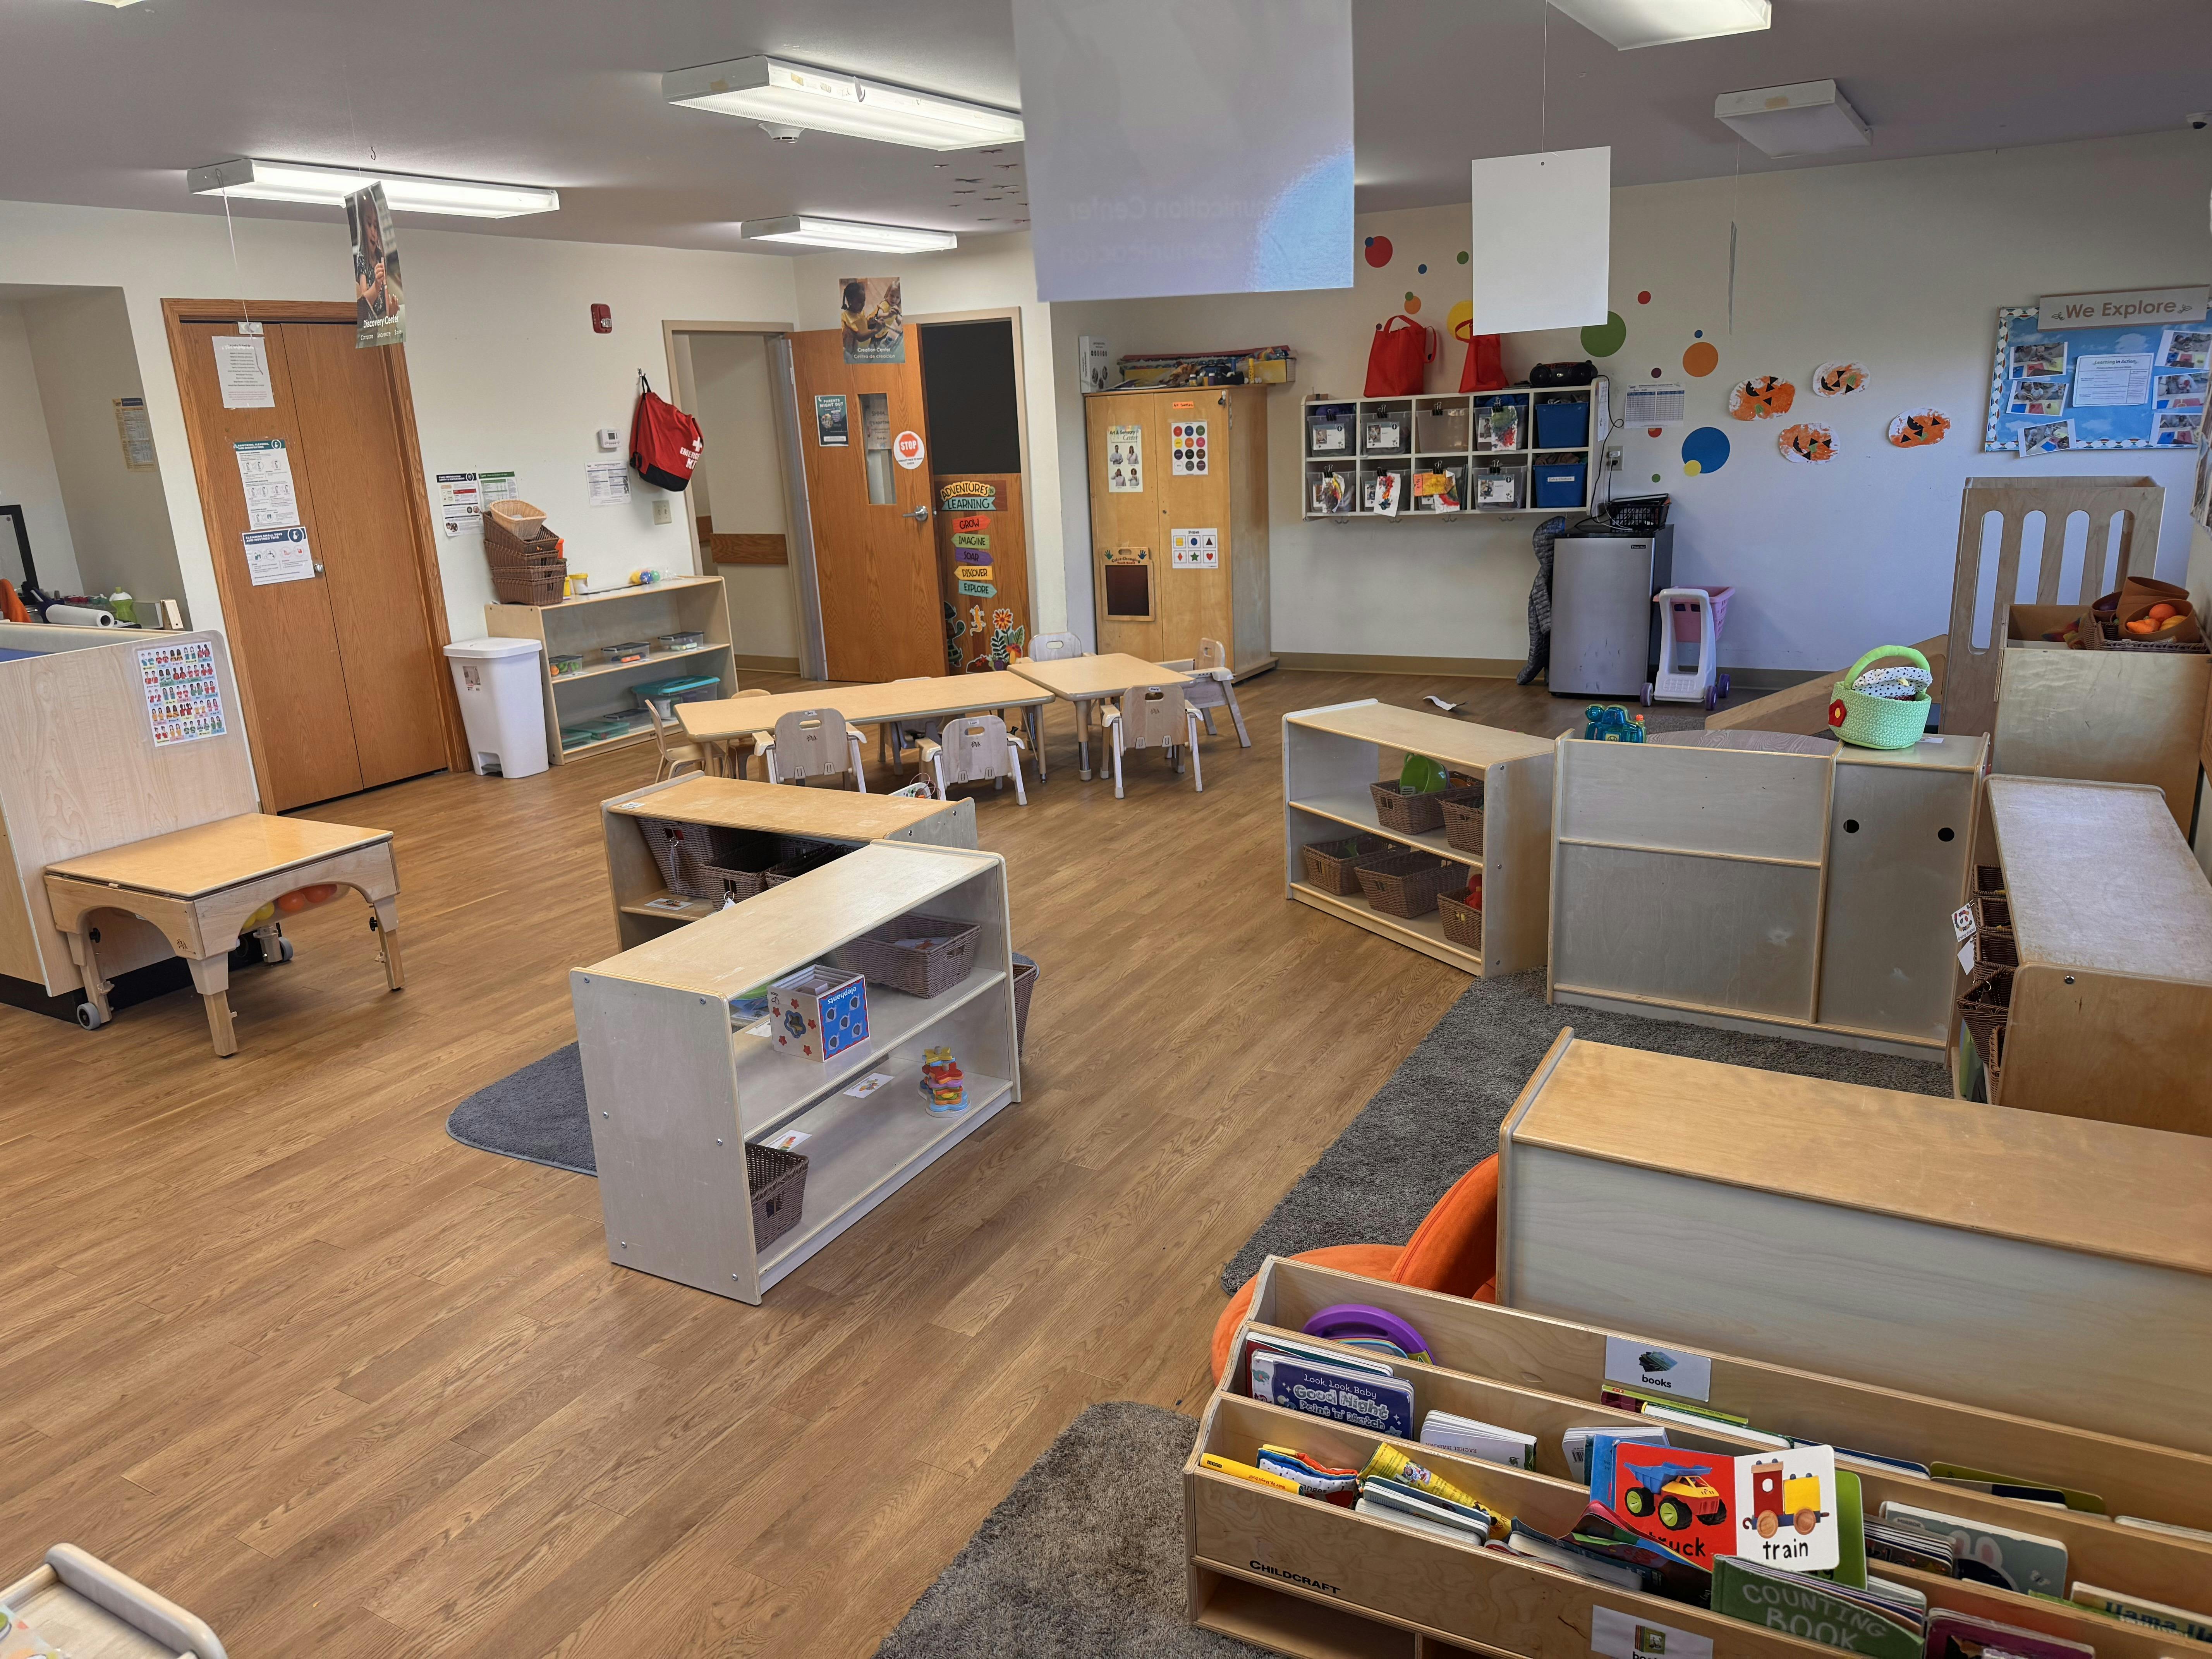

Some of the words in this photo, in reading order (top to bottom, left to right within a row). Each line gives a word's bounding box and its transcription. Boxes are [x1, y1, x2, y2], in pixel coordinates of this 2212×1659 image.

[2066, 304, 2094, 318] We
[2102, 300, 2176, 318] Explore
[363, 318, 384, 328] Discovery
[385, 314, 398, 325] Center
[900, 440, 917, 451] STOP
[685, 458, 697, 470] KI
[941, 483, 988, 500] ADVENTURES
[947, 498, 990, 510] LEARNING
[959, 519, 979, 529] GROW
[959, 536, 986, 545] IMAGINE
[963, 551, 979, 562] SOAR
[962, 568, 988, 577] DISCOVER
[963, 583, 989, 594] EXPLORE
[828, 986, 857, 1004] elephants
[1304, 1374, 1327, 1387] Look,
[1329, 1380, 1352, 1393] Look,
[1353, 1386, 1376, 1400] Baby
[1642, 1374, 1671, 1388] books
[1293, 1384, 1338, 1405] Good
[1339, 1390, 1389, 1420] Night
[1299, 1400, 1331, 1417] Point
[1346, 1412, 1385, 1430] Match
[1897, 1518, 1921, 1527] MIRROR
[1763, 1538, 1808, 1560] train
[1249, 1560, 1341, 1594] CHILDCRAFT
[1743, 1584, 1887, 1637] COUNTING
[1766, 1607, 1858, 1650] BOOK
